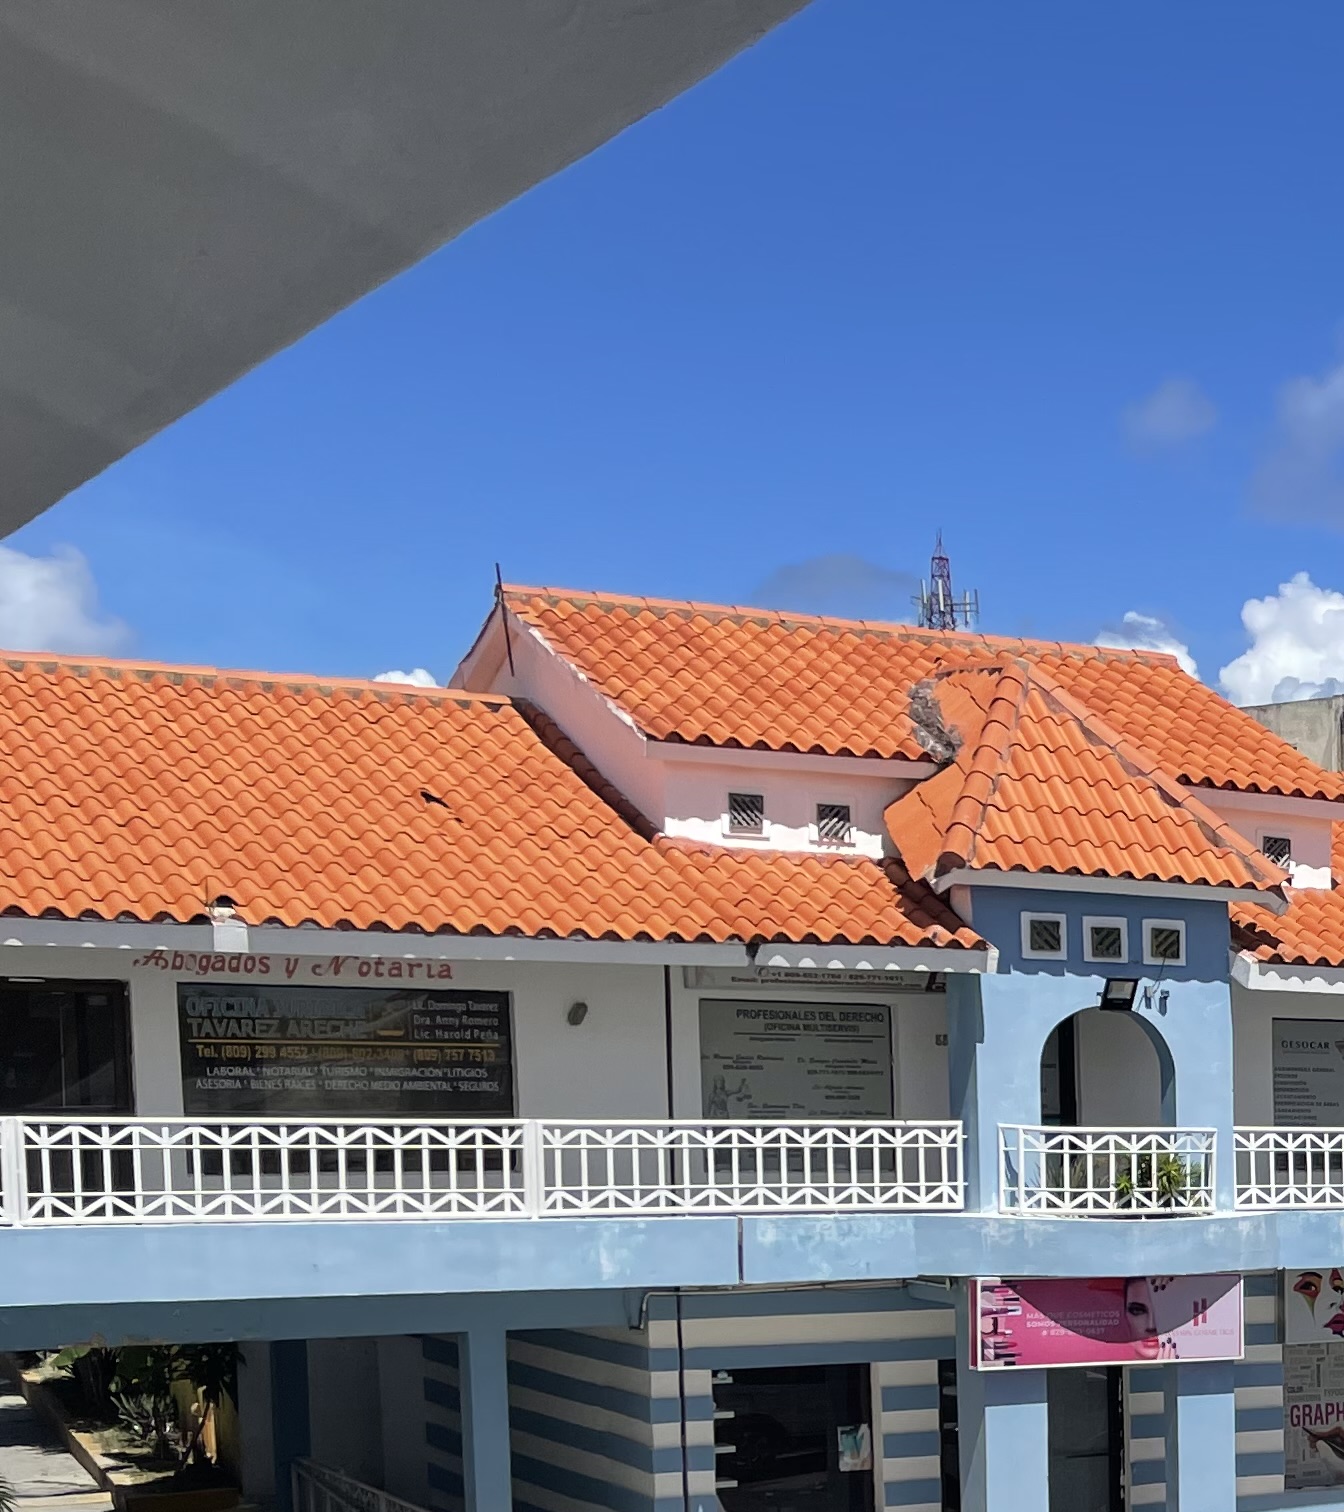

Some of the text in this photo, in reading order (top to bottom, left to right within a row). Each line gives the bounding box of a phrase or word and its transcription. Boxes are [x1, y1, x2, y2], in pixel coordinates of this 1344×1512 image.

[285, 957, 299, 979] y
[186, 997, 268, 1018] OFICINA
[736, 1009, 885, 1023] PROFESIONALES DEL DERECHO
[187, 1018, 281, 1039] TAVAREZ
[1281, 1040, 1330, 1050] GESOCAR
[206, 1066, 255, 1077] LABORAL
